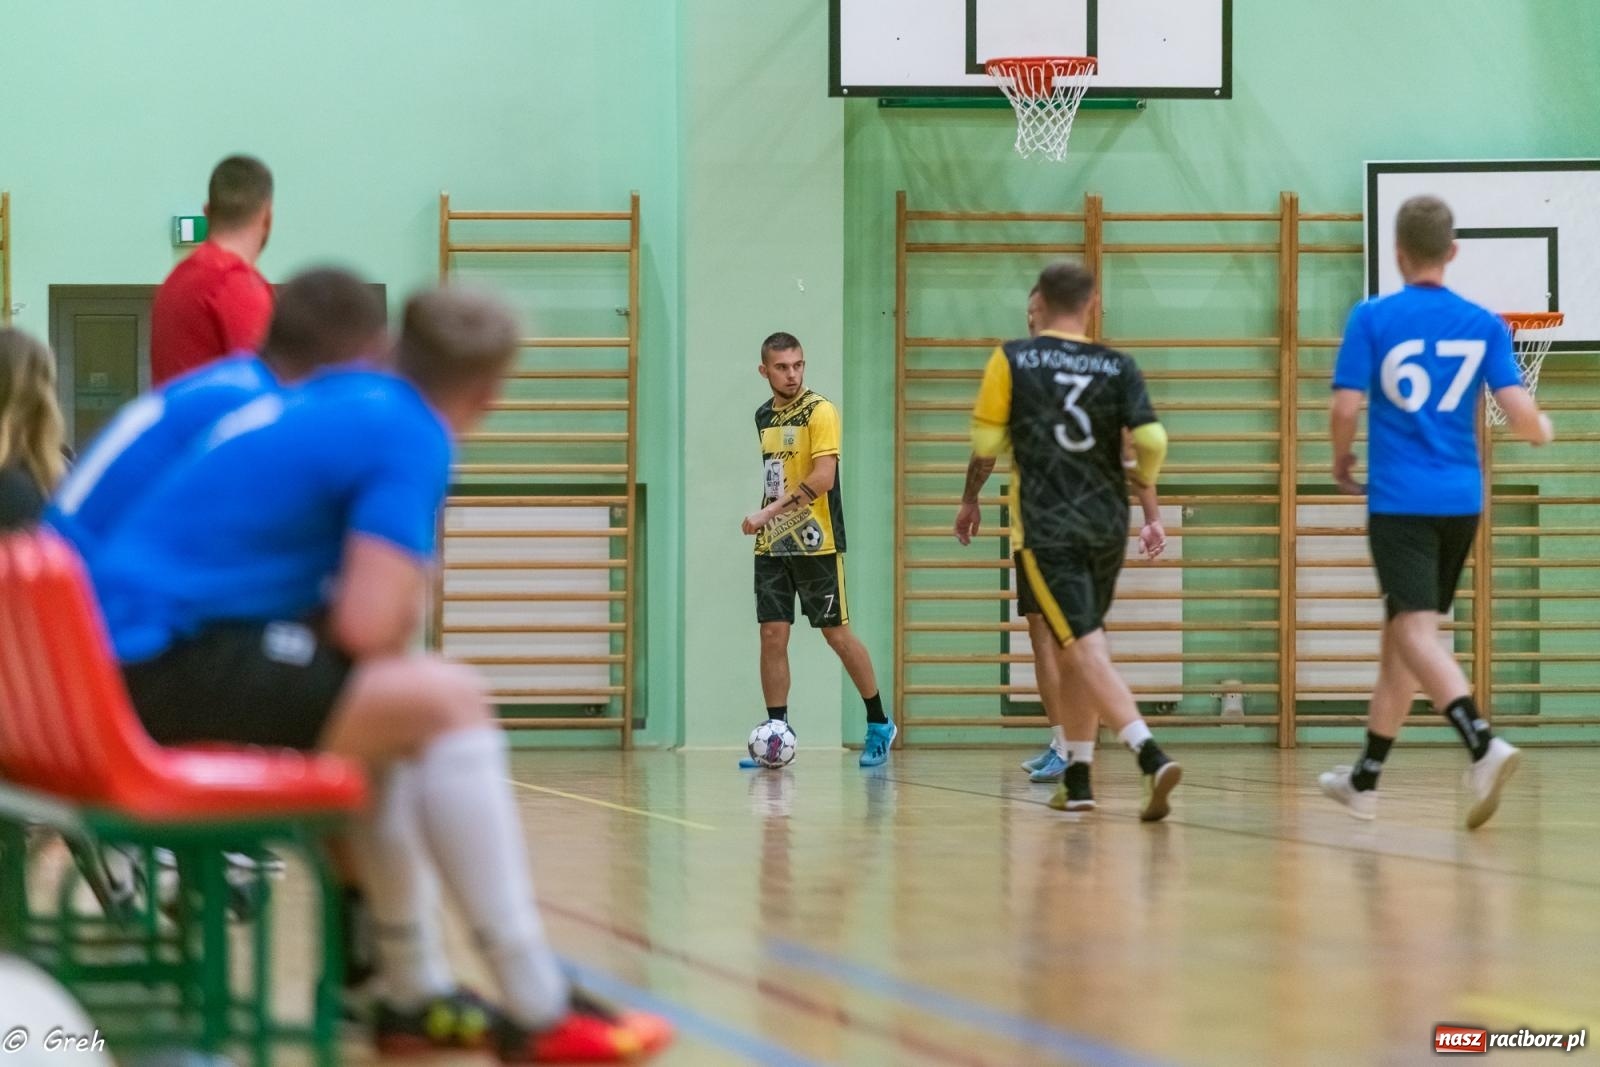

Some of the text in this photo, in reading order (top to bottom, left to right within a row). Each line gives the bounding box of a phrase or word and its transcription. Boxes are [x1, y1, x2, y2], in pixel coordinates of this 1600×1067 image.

[1016, 349, 1040, 369] KS
[1380, 339, 1487, 413] 67
[1053, 372, 1096, 453] 3
[824, 594, 835, 613] 7
